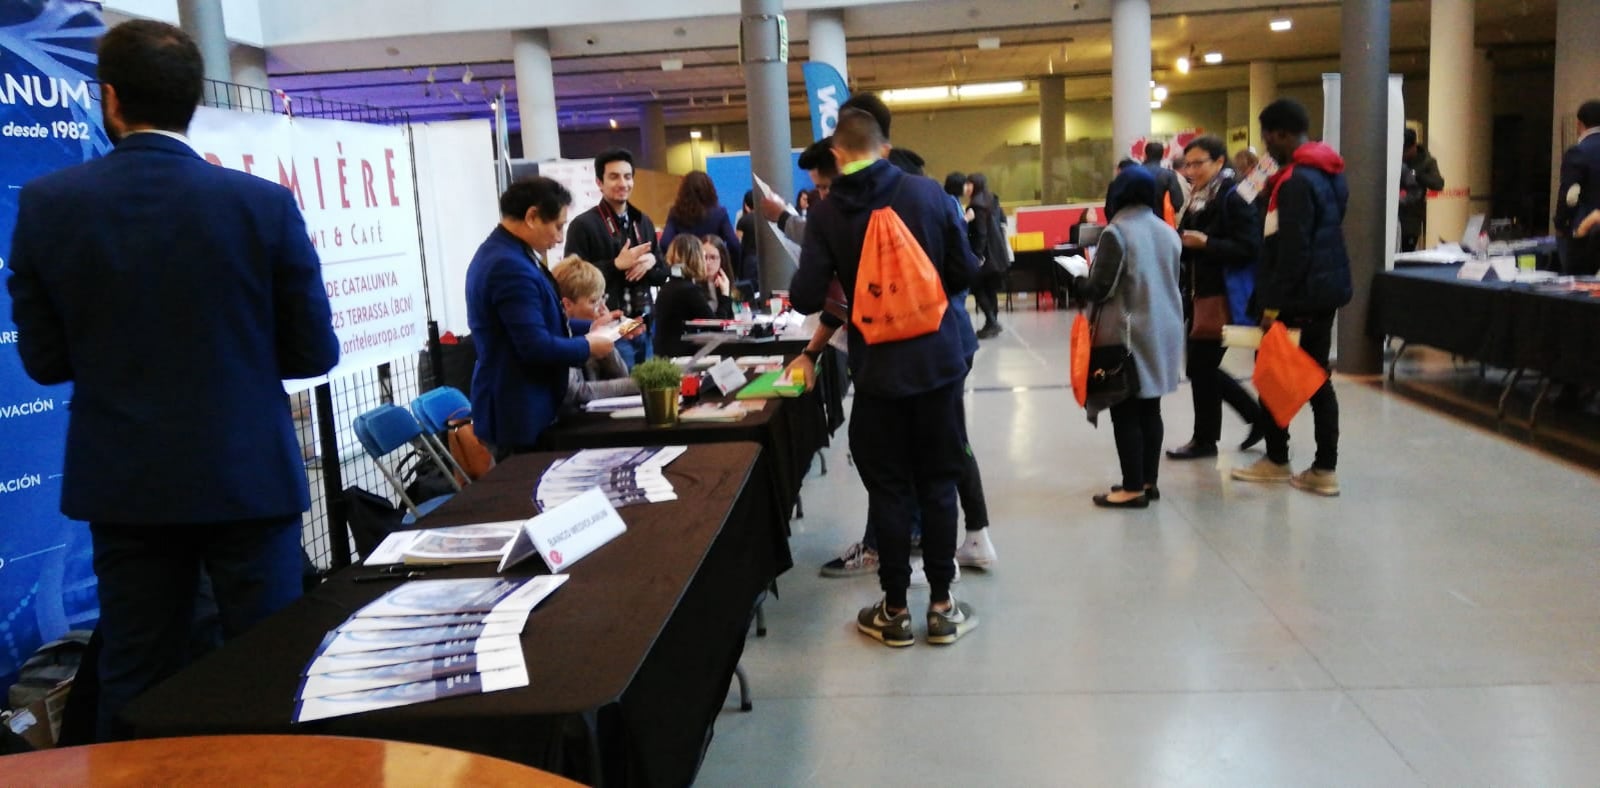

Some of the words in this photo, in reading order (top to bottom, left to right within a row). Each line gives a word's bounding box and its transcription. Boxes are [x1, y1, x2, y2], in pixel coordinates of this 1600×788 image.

[2, 121, 49, 138] desde
[51, 120, 91, 140] 1982
[204, 141, 400, 210] MIÈRE
[334, 225, 342, 247] &
[326, 280, 340, 298] DE
[341, 270, 398, 295] CATALUNYA
[331, 311, 345, 329] 25
[346, 301, 390, 326] TERRASSA
